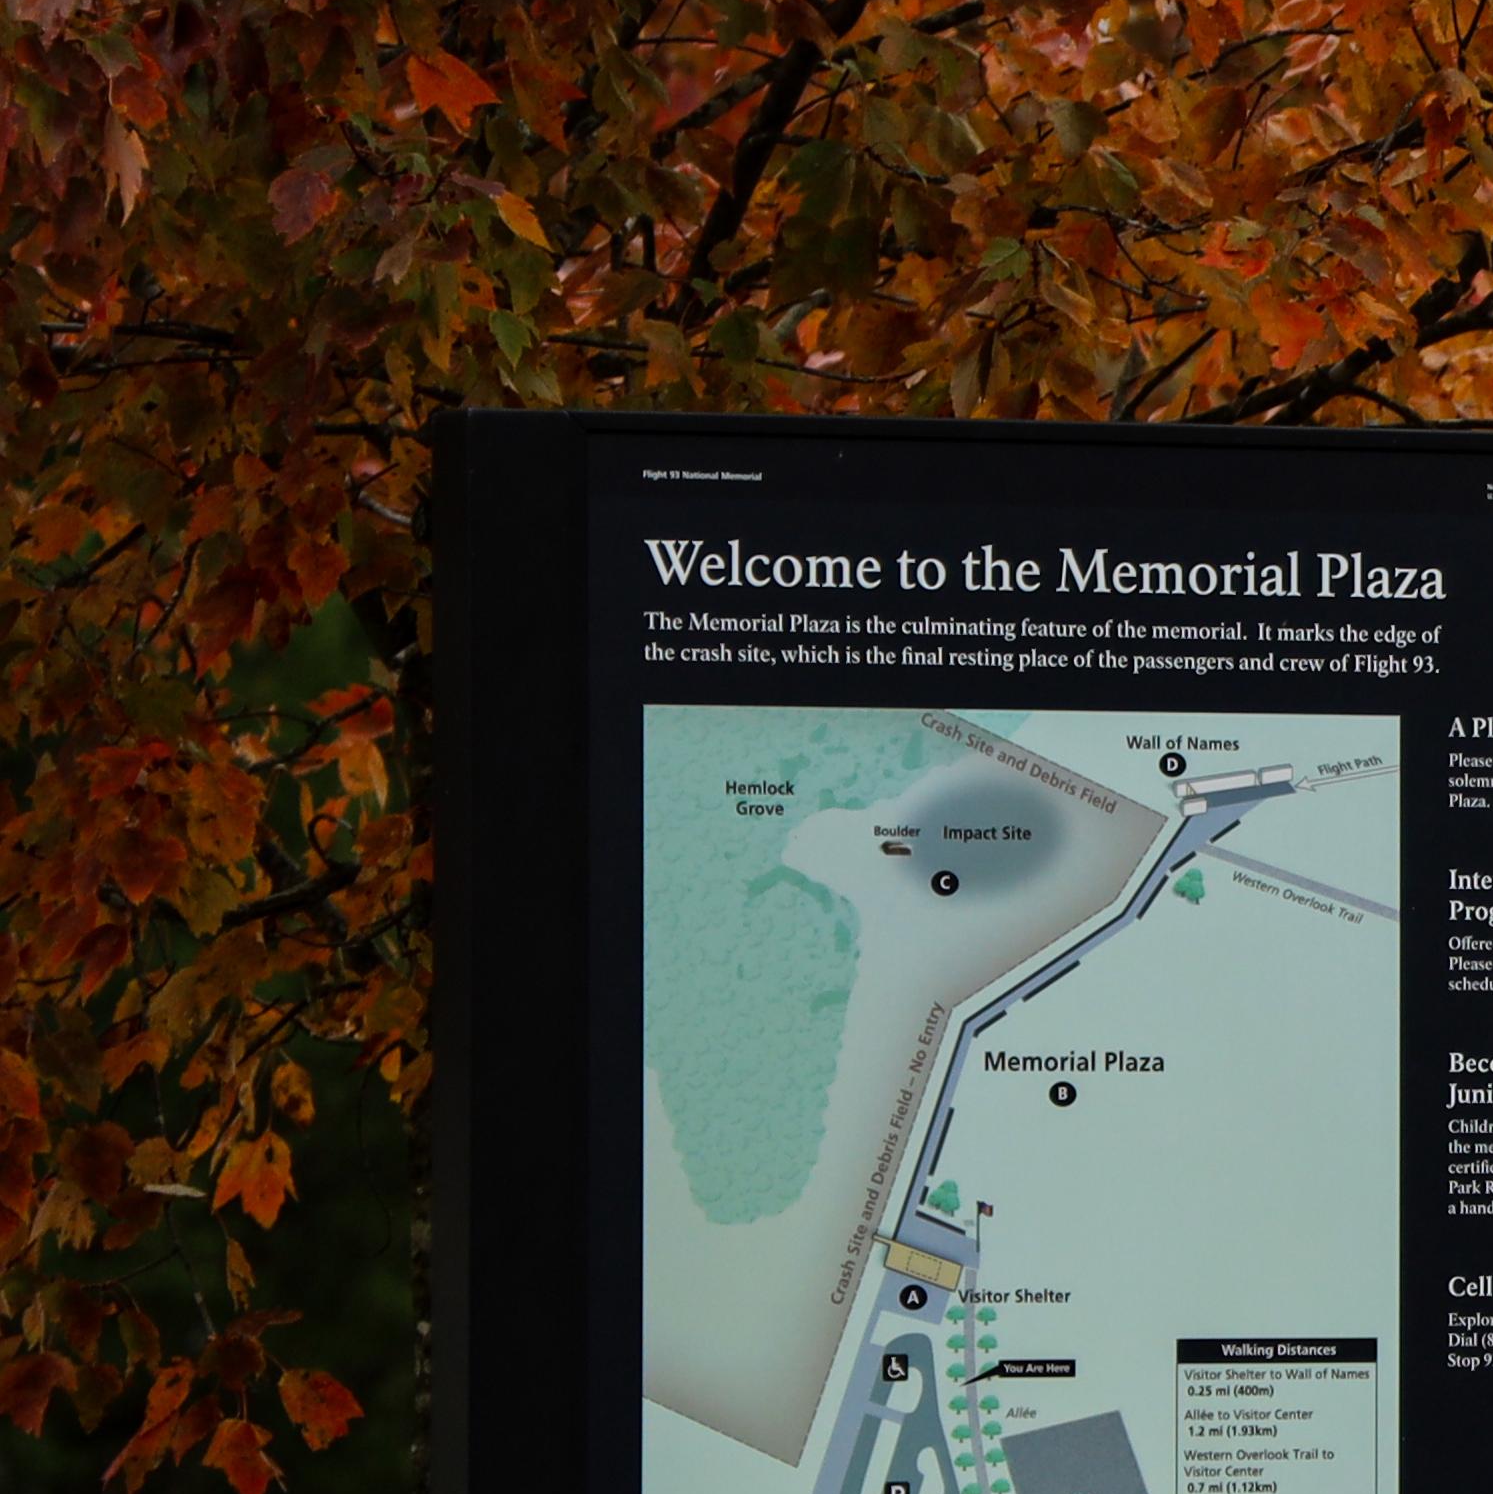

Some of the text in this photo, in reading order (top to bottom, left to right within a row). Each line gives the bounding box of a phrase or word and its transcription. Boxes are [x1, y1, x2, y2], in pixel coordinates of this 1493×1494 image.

[642, 469, 762, 481] Flight 93 National Memorial
[644, 539, 1447, 600] Welcome to the Memorial Plaza
[643, 611, 1442, 649] The Memorial Plaza is the culminating feature of the memorial. It marks the edge of
[644, 641, 1440, 678] the crash site, which is the final resting place of the passengers and crew of Flight 93.
[1448, 716, 1466, 738] A
[1126, 735, 1240, 751] Wall of Names
[921, 713, 1116, 815] Crash Site and Debris Field
[1166, 758, 1178, 771] D
[1318, 755, 1382, 777] Flight Path
[1449, 753, 1493, 768] Please
[726, 780, 795, 796] Hemlock
[736, 800, 784, 816] Grove
[1449, 792, 1490, 808] Plaza.
[874, 825, 921, 837] Boulder
[944, 825, 1032, 843] Impact Site
[940, 875, 950, 890] C
[1232, 871, 1364, 924] Western Overlook Trail
[984, 1051, 1164, 1072] Memorial Plaza
[1058, 1087, 1068, 1100] B
[831, 1258, 856, 1305] Crash
[848, 1224, 868, 1256] Site
[862, 1188, 880, 1221] and
[871, 1133, 898, 1185] Debris
[890, 1089, 913, 1129] Field
[908, 1049, 926, 1073] No
[918, 1001, 945, 1045] Entry
[1448, 1275, 1492, 1297] Cell
[906, 1290, 920, 1305] A
[958, 1288, 1071, 1303] Visitor Shelter
[1221, 1343, 1336, 1359] Walking Distances
[1004, 1364, 1070, 1373] You Are Here
[1184, 1369, 1370, 1381] Visitor Shelter to Wall of Names
[1187, 1385, 1212, 1397] 0.25
[1233, 1384, 1274, 1397] (400m)
[1005, 1407, 1037, 1419] Allée
